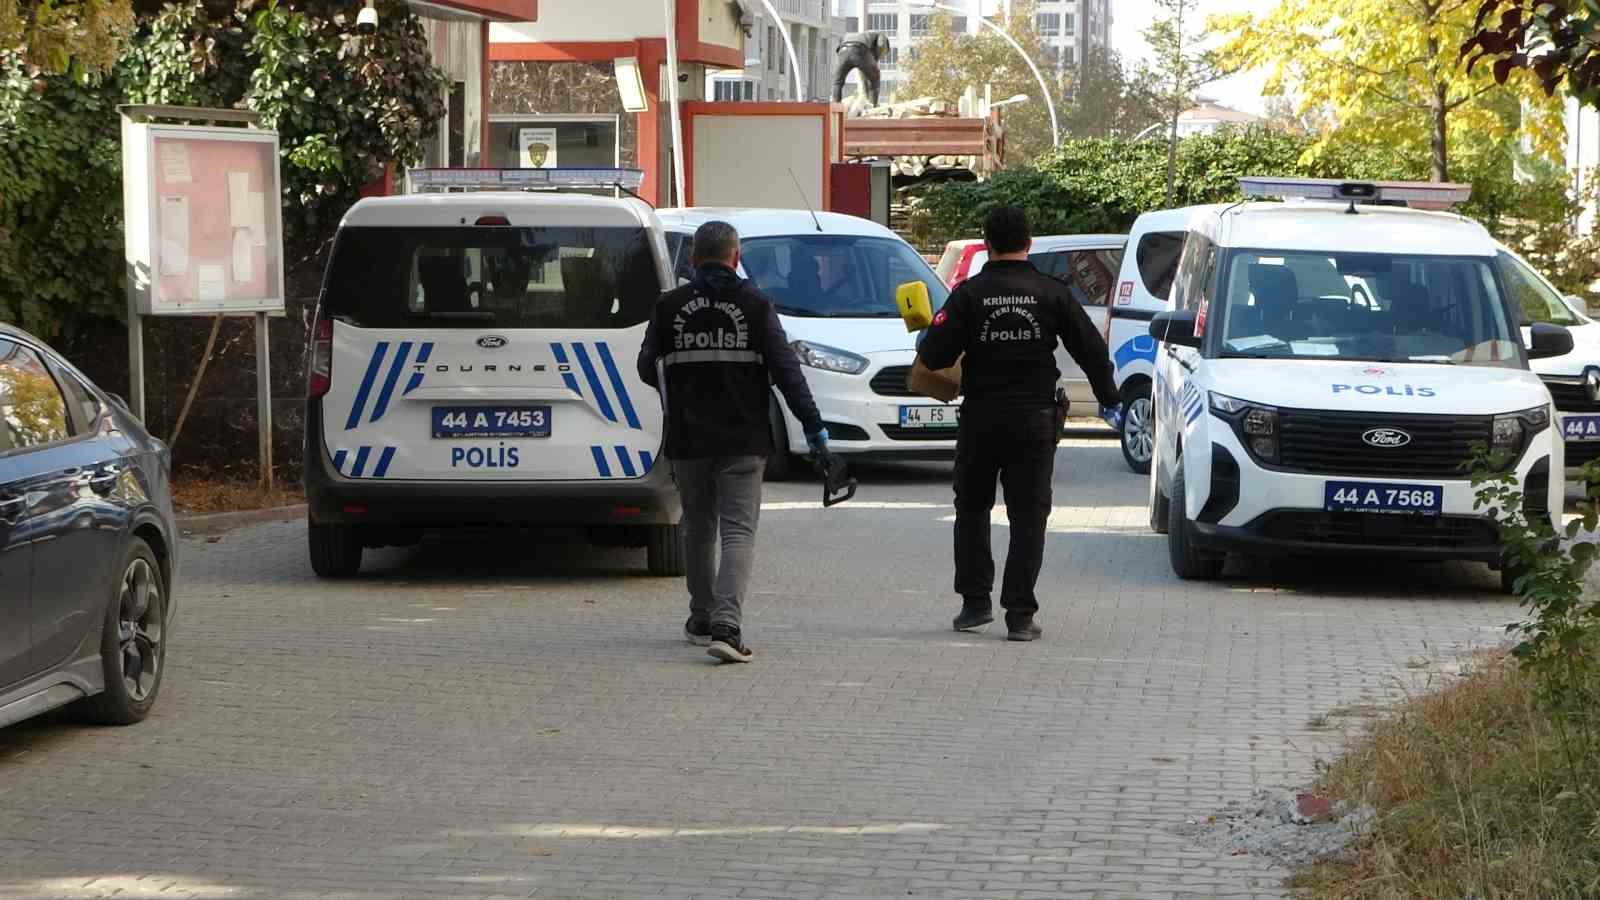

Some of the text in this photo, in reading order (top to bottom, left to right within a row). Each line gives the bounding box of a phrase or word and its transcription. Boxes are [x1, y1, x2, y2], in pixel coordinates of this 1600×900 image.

[413, 364, 571, 372] TOURNEO
[1331, 383, 1436, 397] POLİS
[442, 410, 545, 429] 44 A 7453
[908, 408, 921, 422] 44
[930, 408, 944, 421] FS
[1566, 421, 1597, 434] 44 A
[1370, 430, 1402, 445] Ford
[451, 441, 519, 467] POLİS
[1333, 488, 1435, 506] 44 A 7568
